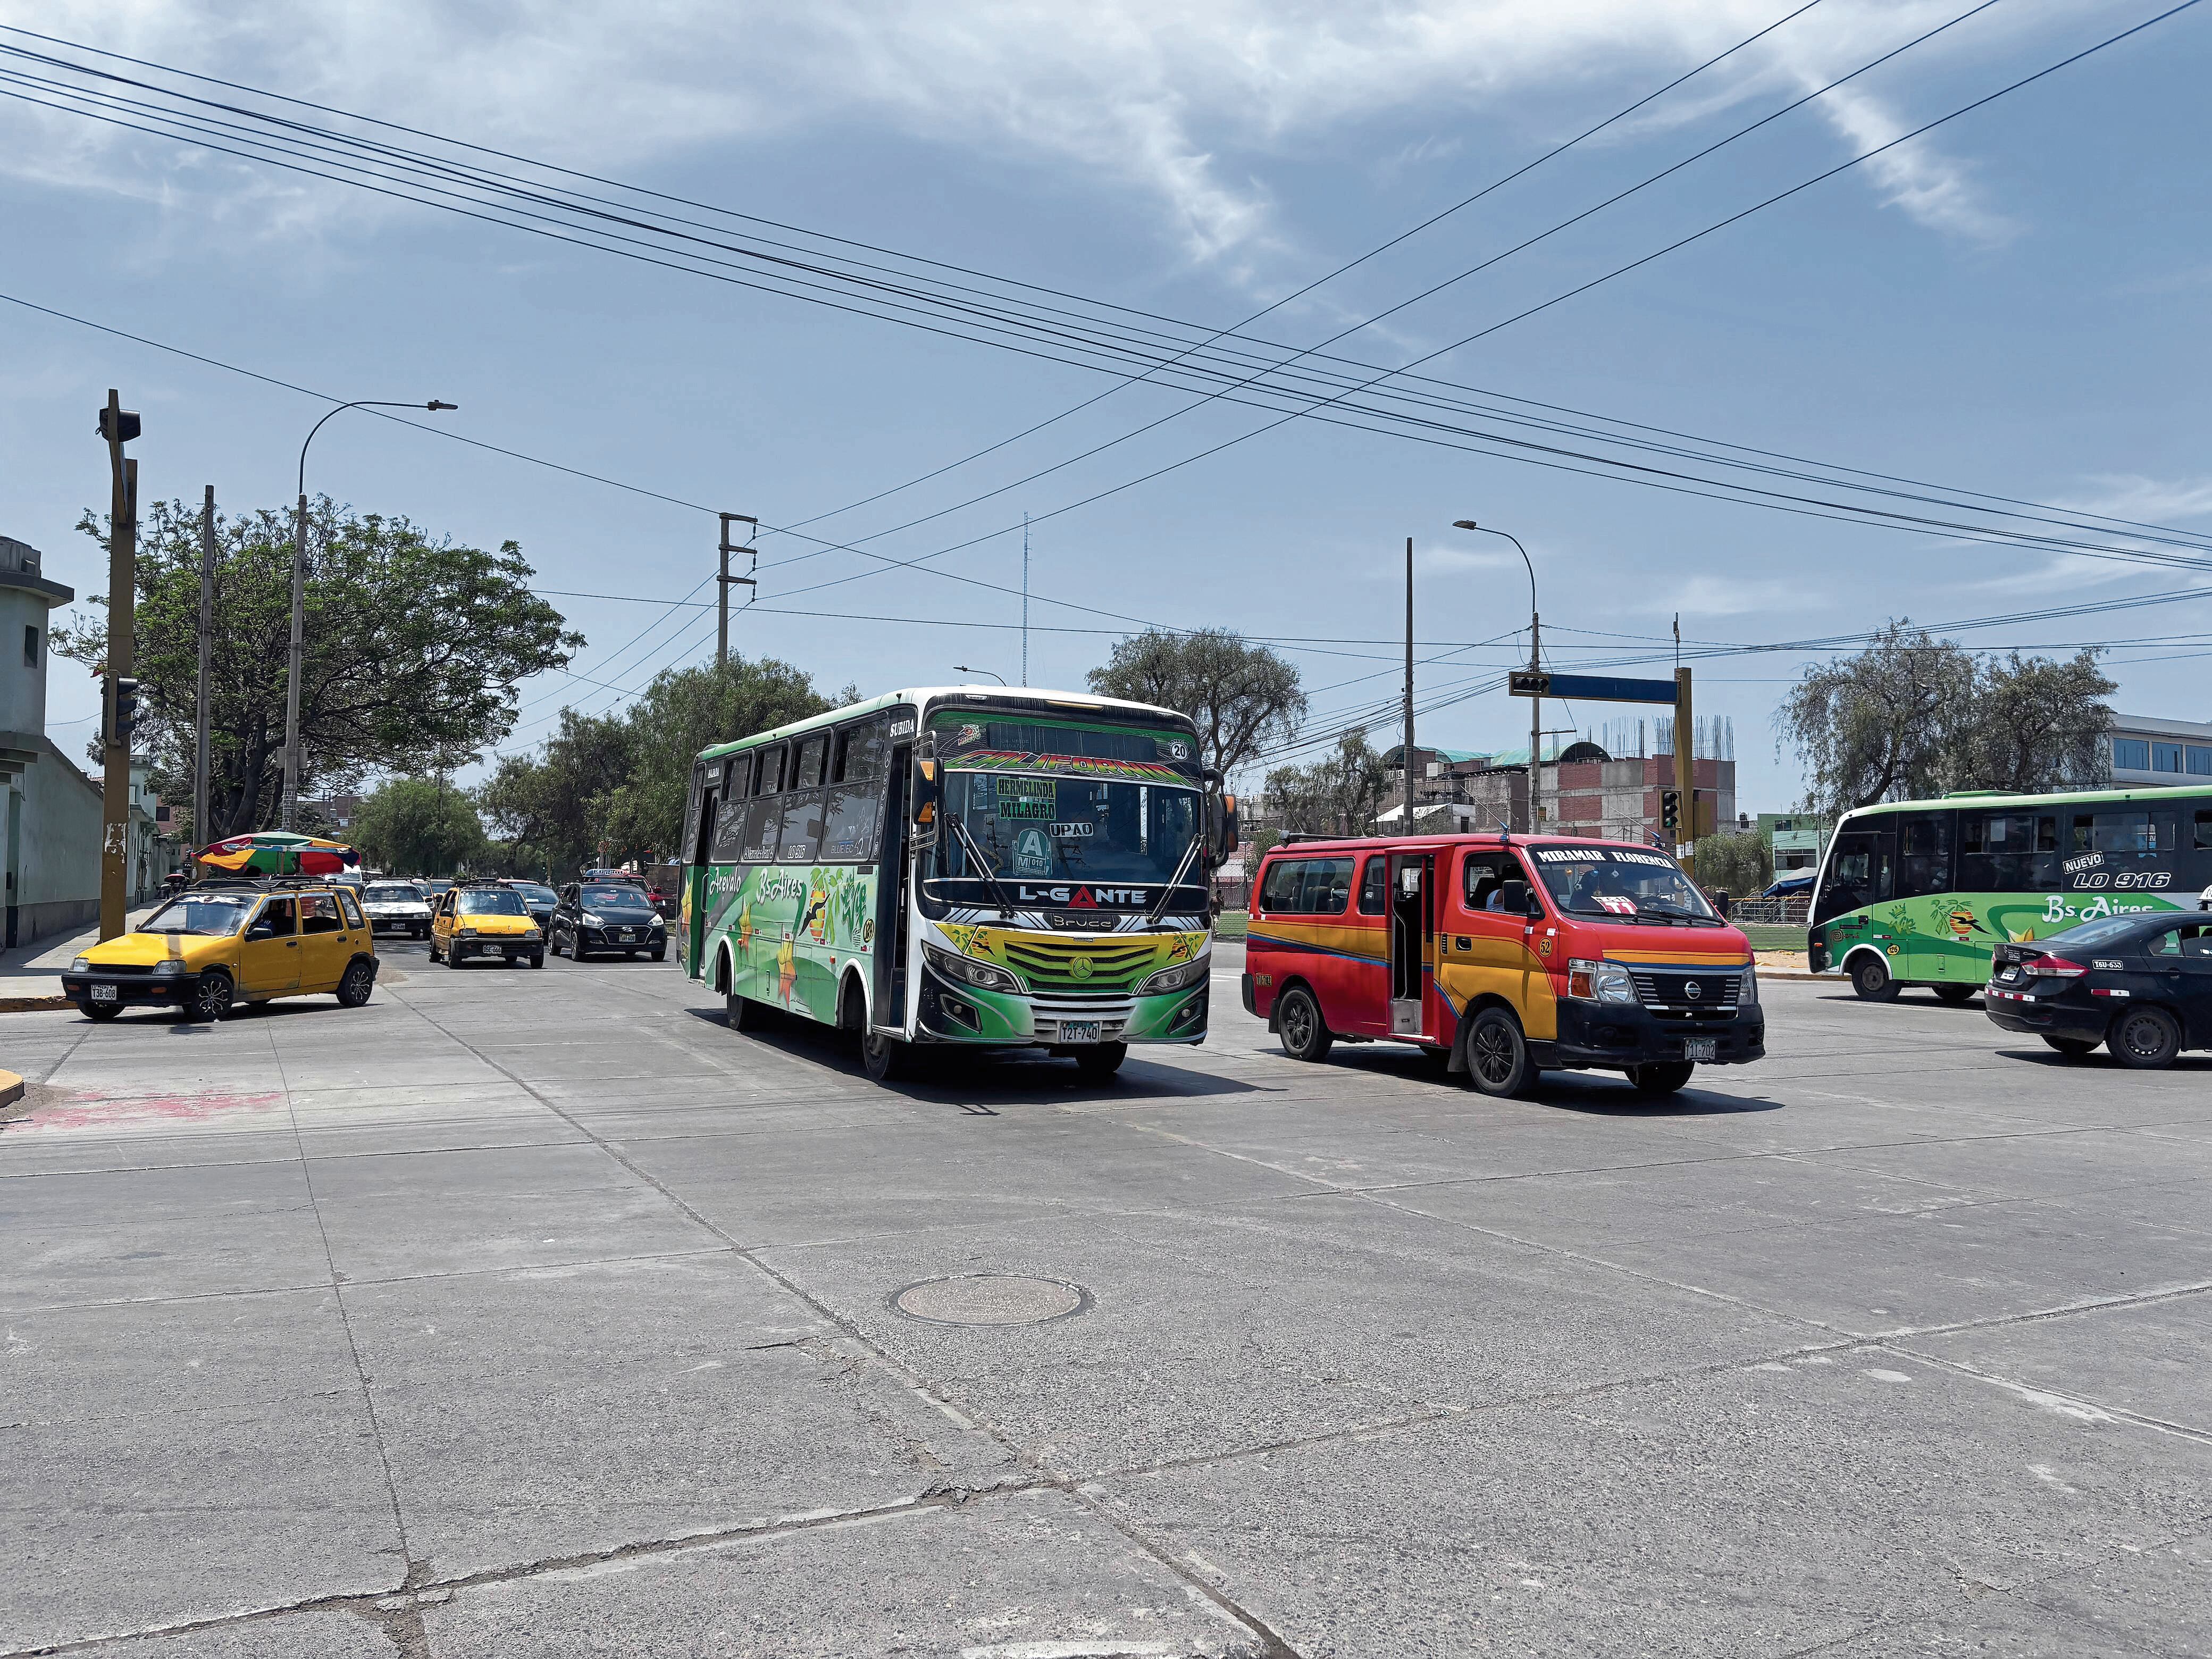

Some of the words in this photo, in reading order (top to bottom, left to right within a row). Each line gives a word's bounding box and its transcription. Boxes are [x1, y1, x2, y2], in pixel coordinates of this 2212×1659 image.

[890, 718, 915, 738] SUBIDA
[1174, 744, 1186, 757] 20
[944, 750, 1195, 788] CALIFORNIA
[998, 778, 1054, 797] HERMELINDA
[1000, 801, 1055, 819] MILAGRO
[1050, 823, 1093, 836] UPAO
[1021, 831, 1043, 857] A
[1017, 856, 1028, 868] M
[1032, 858, 1043, 867] 010
[1536, 850, 1606, 862] MIRAMAR
[1613, 851, 1675, 869] FLORENCIA
[2065, 853, 2102, 873] NUEVO
[709, 866, 741, 895] Arévalo
[757, 868, 772, 905] Bs
[771, 868, 804, 902] Aires
[2073, 873, 2109, 888] LO
[2114, 873, 2172, 888] 916
[1019, 885, 1147, 908] L-GANTE
[1540, 941, 1550, 953] 52
[92, 988, 115, 998] T3B-608
[1062, 1027, 1098, 1040] T2T-740
